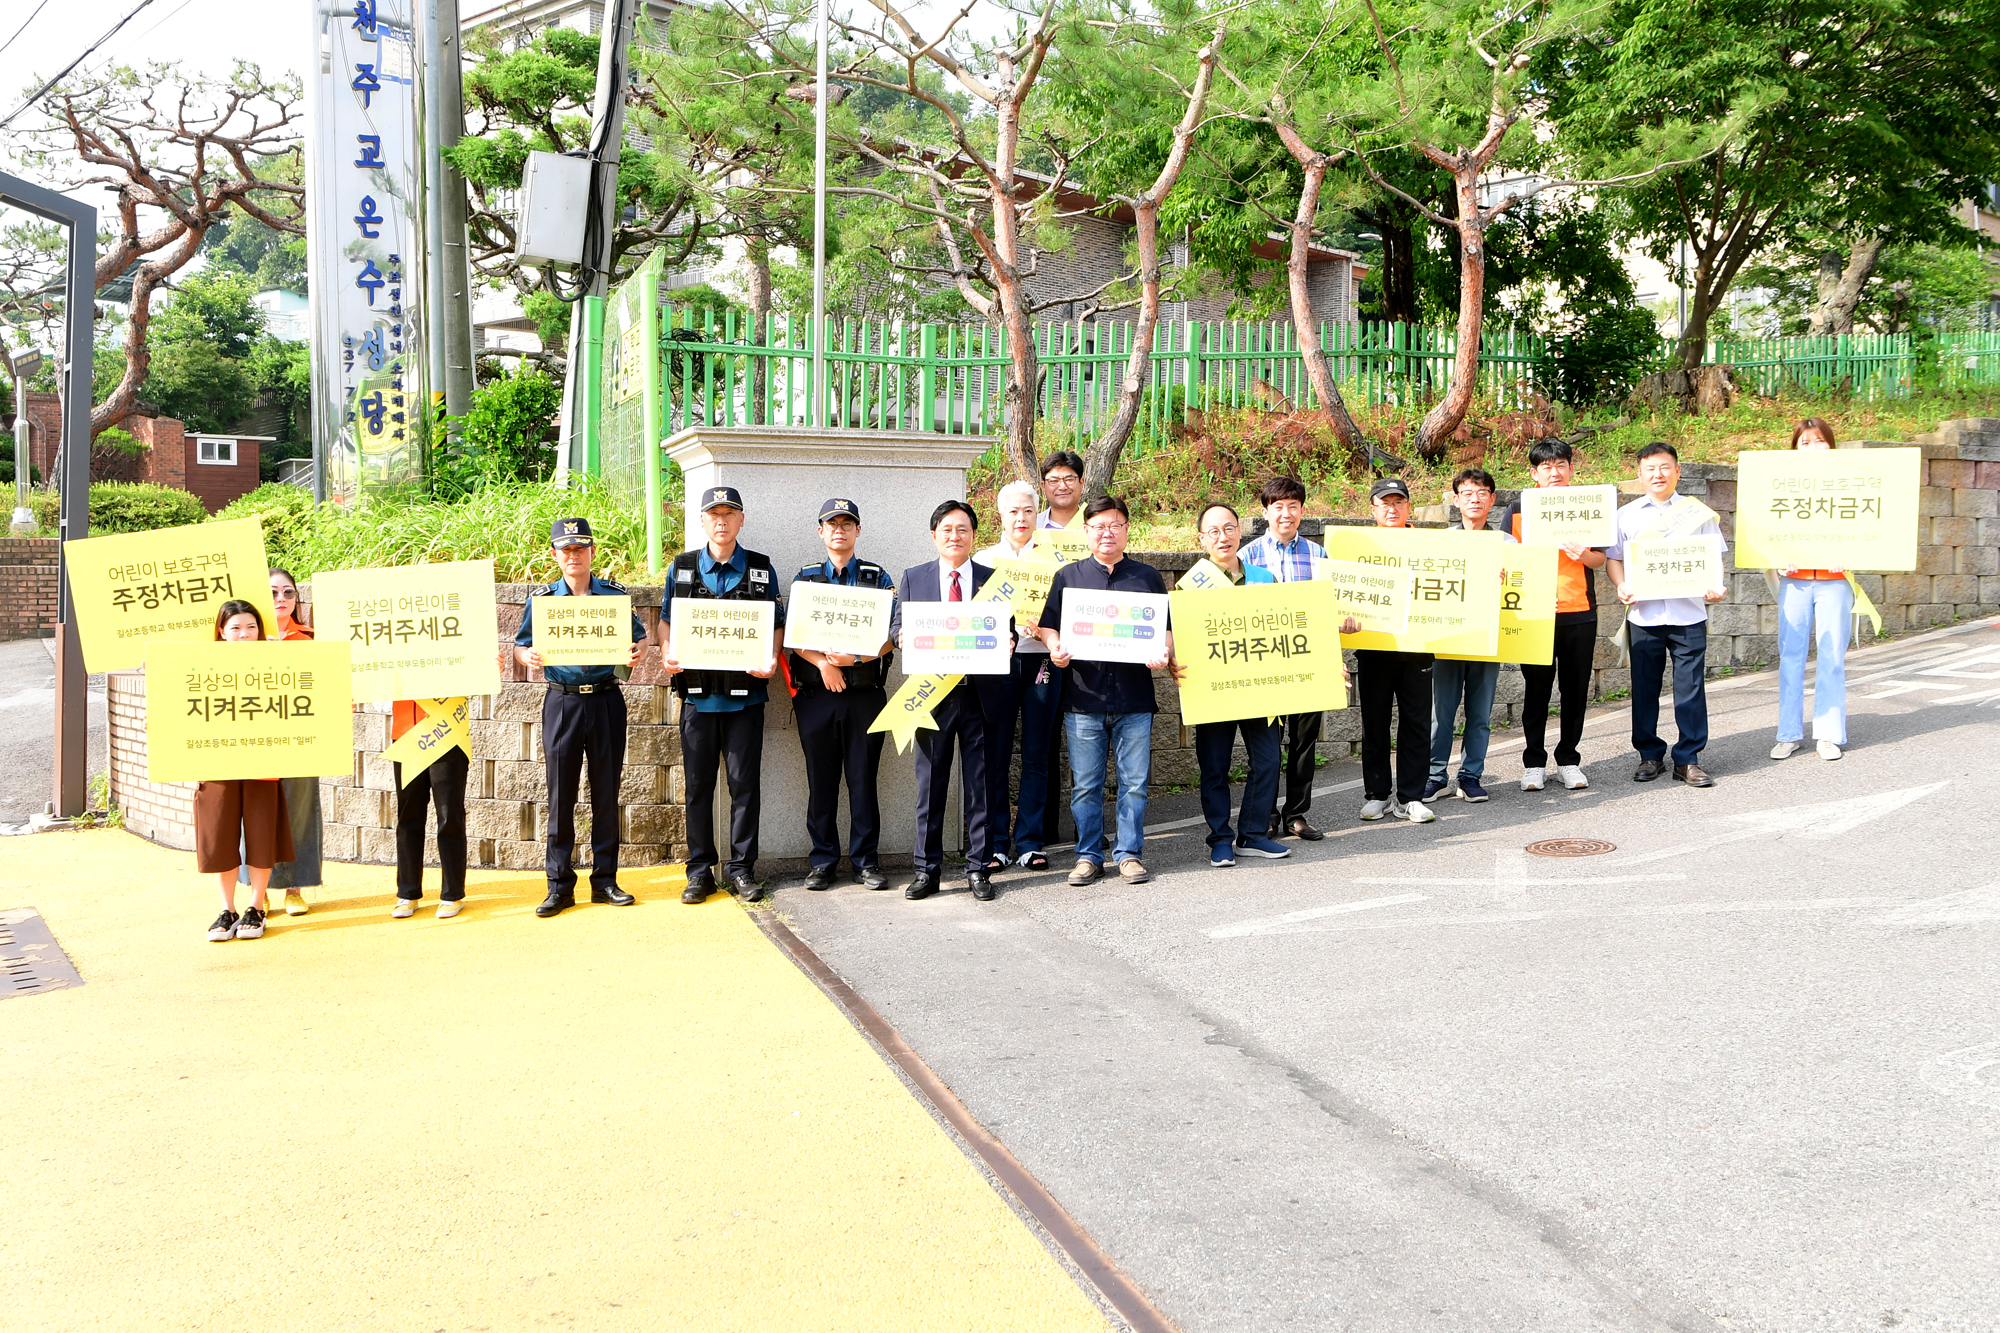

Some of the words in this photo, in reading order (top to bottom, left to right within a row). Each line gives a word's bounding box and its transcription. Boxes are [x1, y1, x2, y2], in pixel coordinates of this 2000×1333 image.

[1773, 477, 1815, 493] 어린이
[1821, 476, 1882, 492] 보호구역
[1540, 495, 1565, 506] 길상의
[1569, 493, 1603, 505] 어린이를
[1770, 497, 1881, 519] 주정차금지
[1541, 509, 1603, 522] 지켜주세요
[1645, 548, 1669, 557] 어린이
[1673, 545, 1706, 555] 보호구역
[108, 560, 159, 582] 어린이
[163, 552, 229, 575] 보호구역
[1407, 557, 1466, 574] 보호구역
[1646, 559, 1705, 574] 주정차금지
[1360, 575, 1395, 589] 어린이를
[112, 573, 234, 612] 주정차금지
[348, 597, 393, 618] 길상의
[398, 592, 461, 613] 어린이를
[812, 595, 838, 606] 어린이
[842, 598, 876, 610] 보호구역
[546, 608, 575, 619] 길상의
[580, 607, 618, 619] 어린이를
[691, 608, 718, 620] 길상의
[723, 610, 759, 621] 어린이를
[810, 610, 873, 627] 주정차금지
[116, 624, 166, 639] 길상초등학교
[349, 616, 463, 646] 지켜주세요
[548, 625, 618, 638] 지켜주세요
[691, 625, 758, 640] 지켜주세요
[1204, 615, 1248, 637] 길상의
[1251, 611, 1308, 631] 어린이를
[1207, 634, 1311, 664] 지켜주세요
[186, 672, 238, 692] 길상의
[244, 671, 315, 690] 어린이를
[1210, 679, 1252, 691] 길상초등학교
[1253, 674, 1295, 686] 학부모동아리
[187, 694, 315, 722] 지켜주세요
[186, 738, 238, 749] 길상초등학교
[239, 736, 290, 747] 학부모동아리
